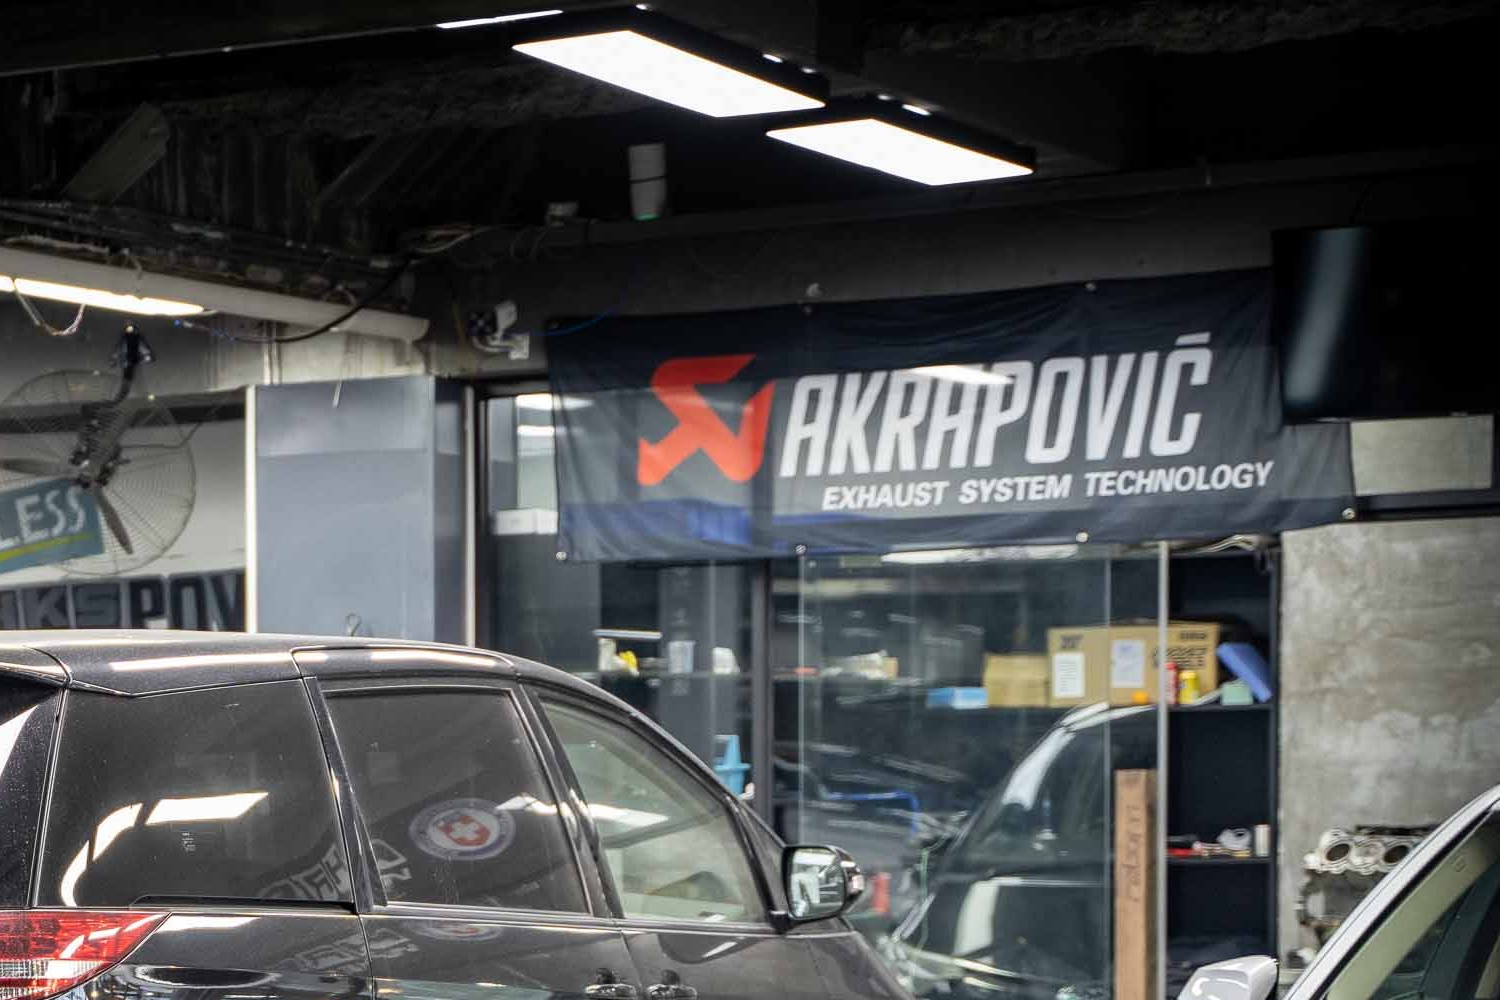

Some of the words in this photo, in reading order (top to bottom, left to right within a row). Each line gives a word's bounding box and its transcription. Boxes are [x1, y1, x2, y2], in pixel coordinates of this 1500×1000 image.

[822, 481, 950, 511] EXHAUST
[958, 474, 1073, 504] SYSTEM
[1084, 461, 1274, 497] TECHNOLOGY
